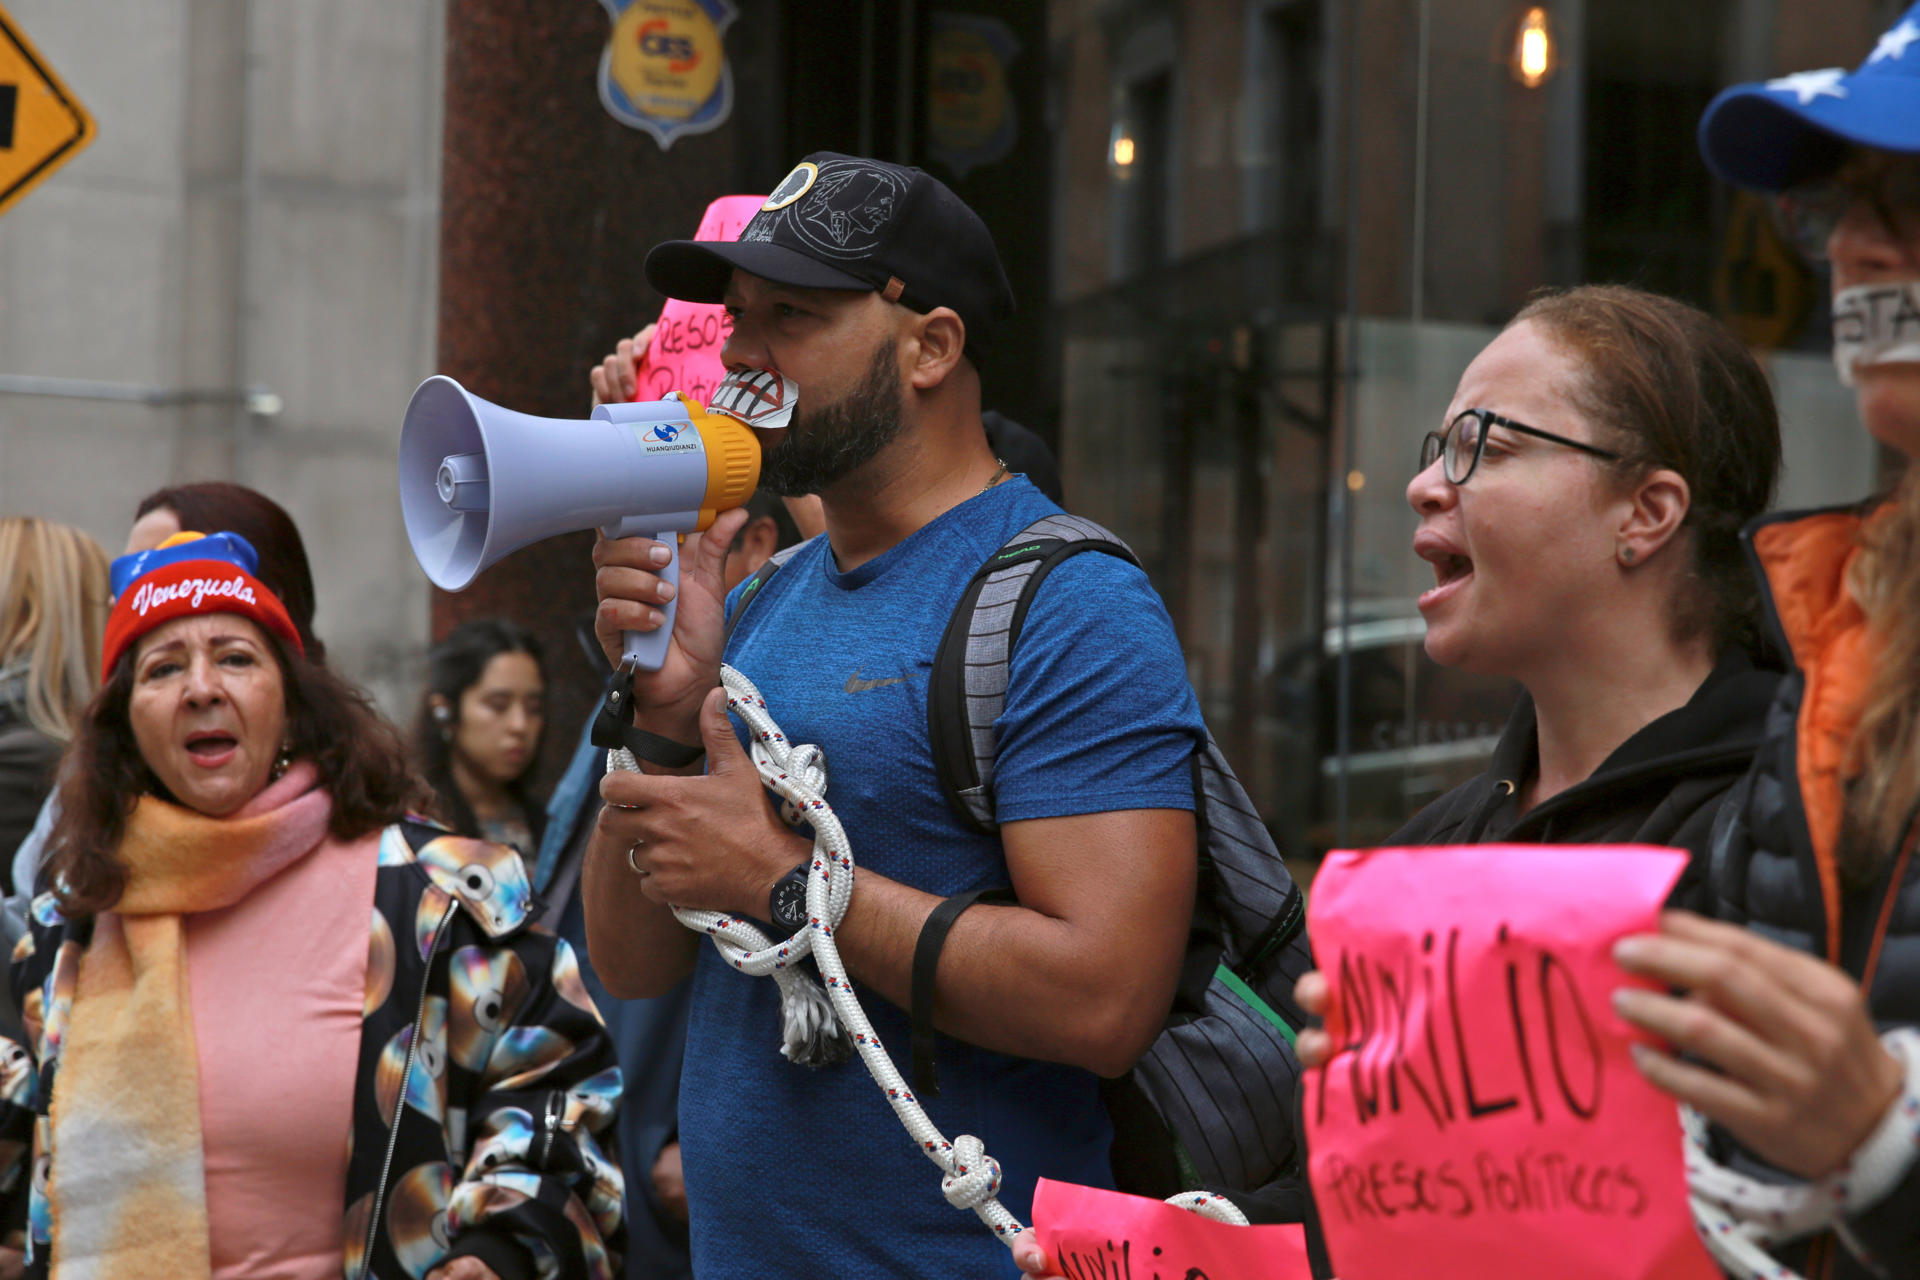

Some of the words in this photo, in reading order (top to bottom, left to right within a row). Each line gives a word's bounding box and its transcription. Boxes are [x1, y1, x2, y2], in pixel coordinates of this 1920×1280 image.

[646, 443, 697, 453] HUANQIUDIANZI
[131, 575, 256, 616] Venezuela
[1323, 1152, 1474, 1225] PRESOS
